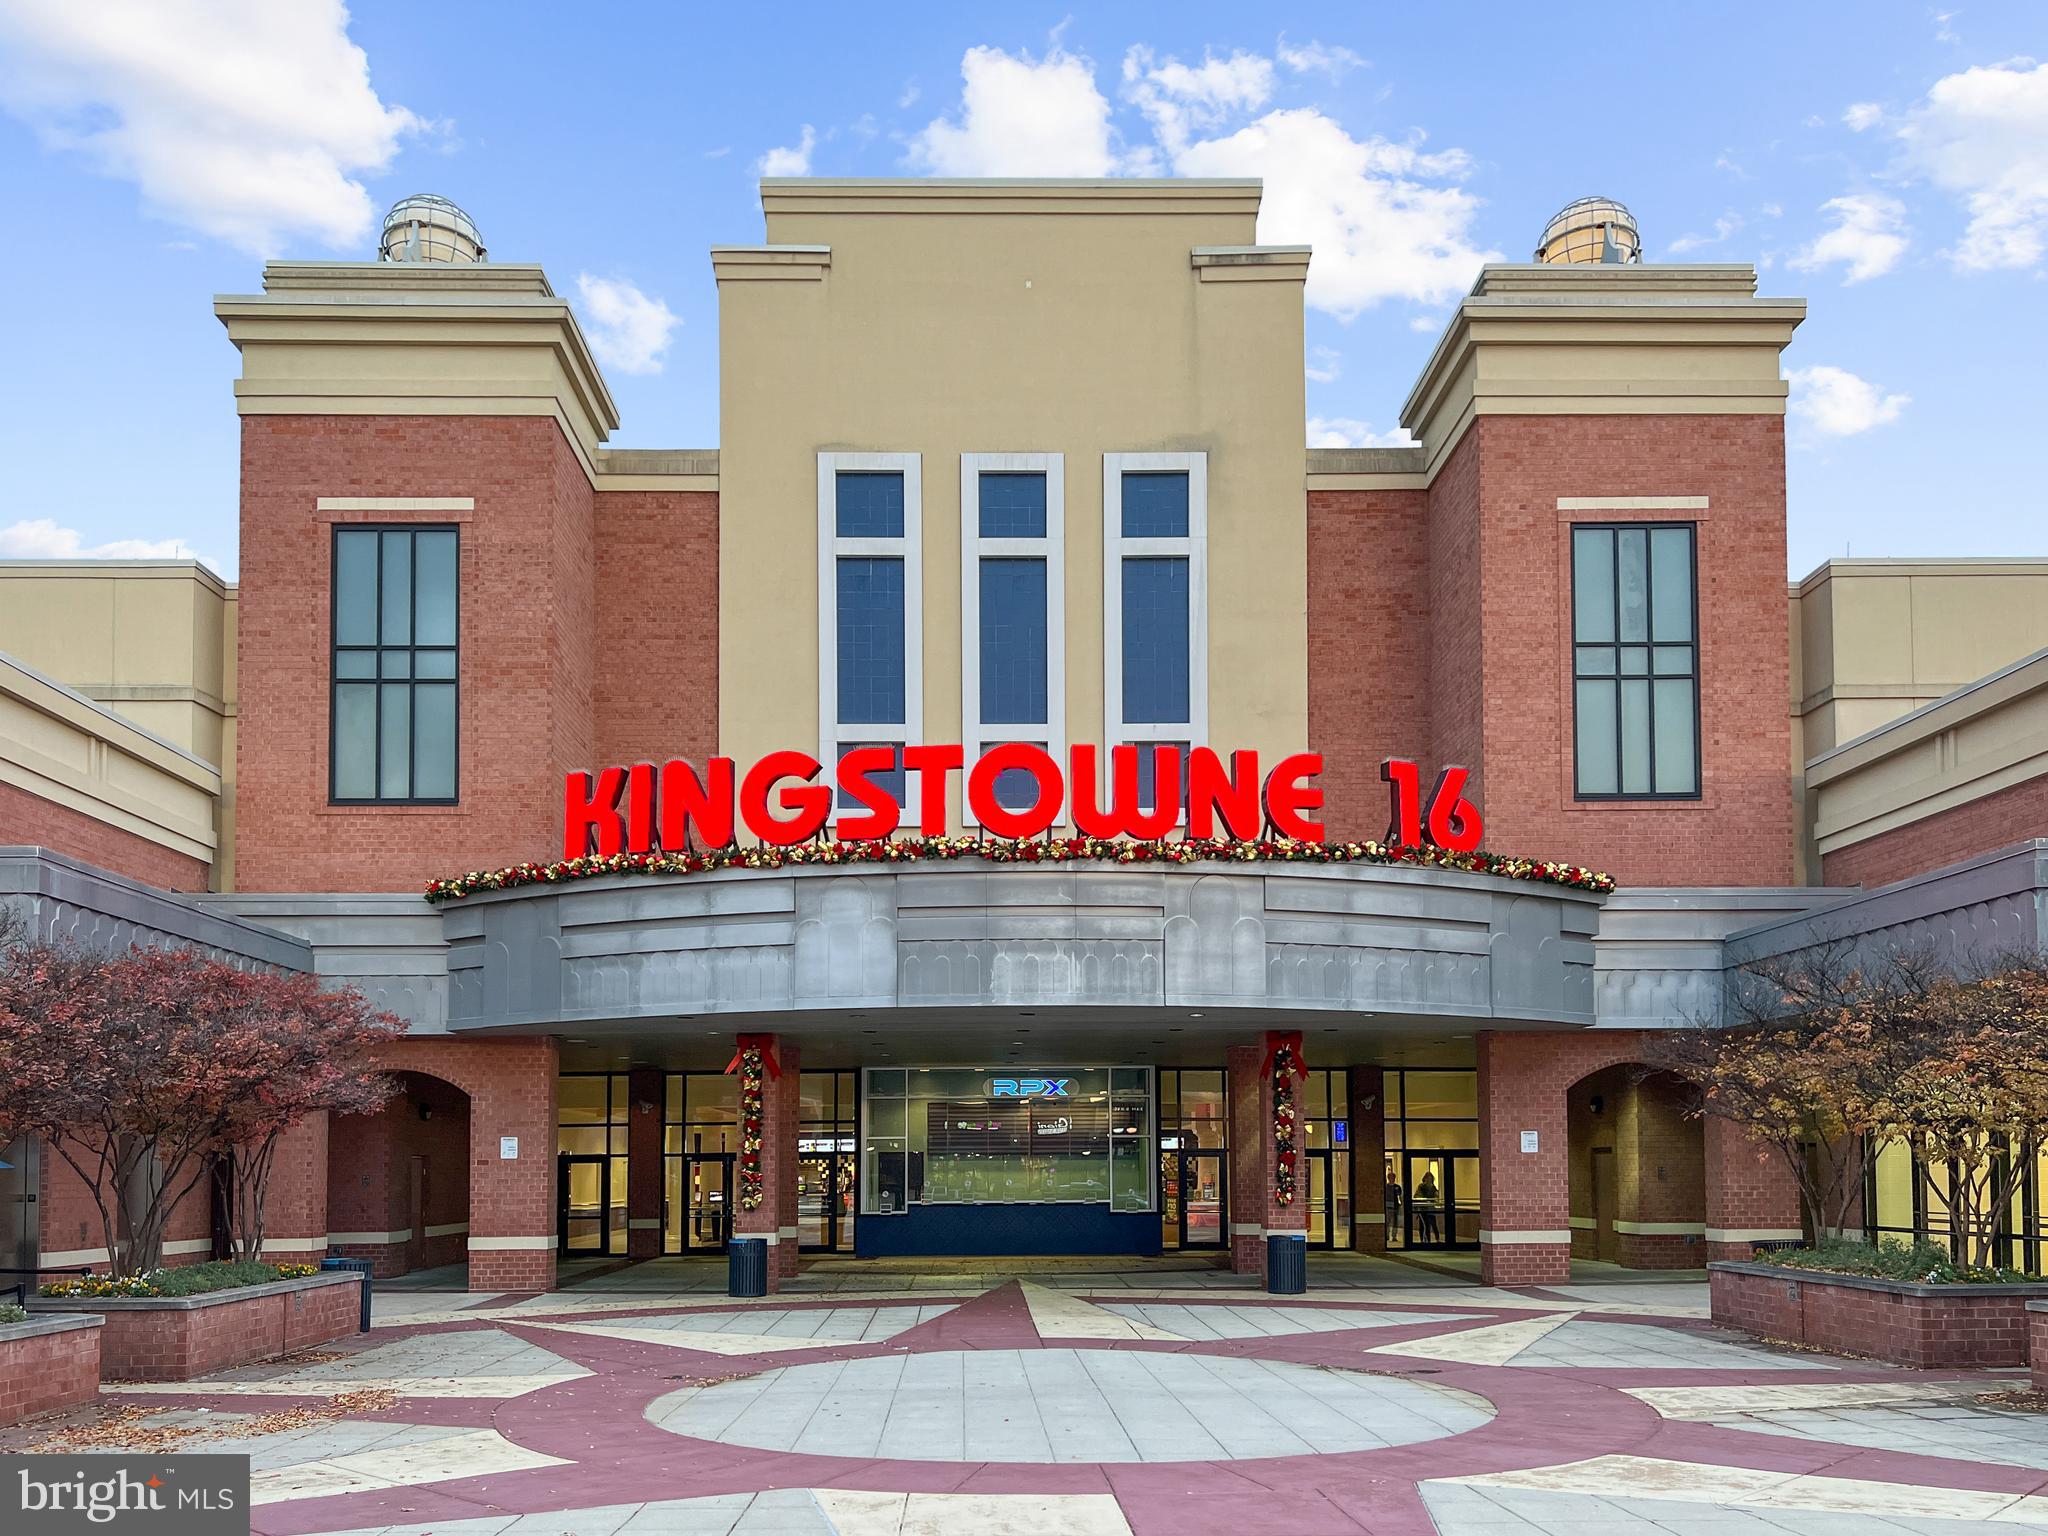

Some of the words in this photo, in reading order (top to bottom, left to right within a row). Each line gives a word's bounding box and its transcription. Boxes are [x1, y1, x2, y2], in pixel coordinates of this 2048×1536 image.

[564, 743, 1325, 859] KINGSTOWNE
[1380, 760, 1482, 852] 16
[993, 1079, 1069, 1096] RPX
